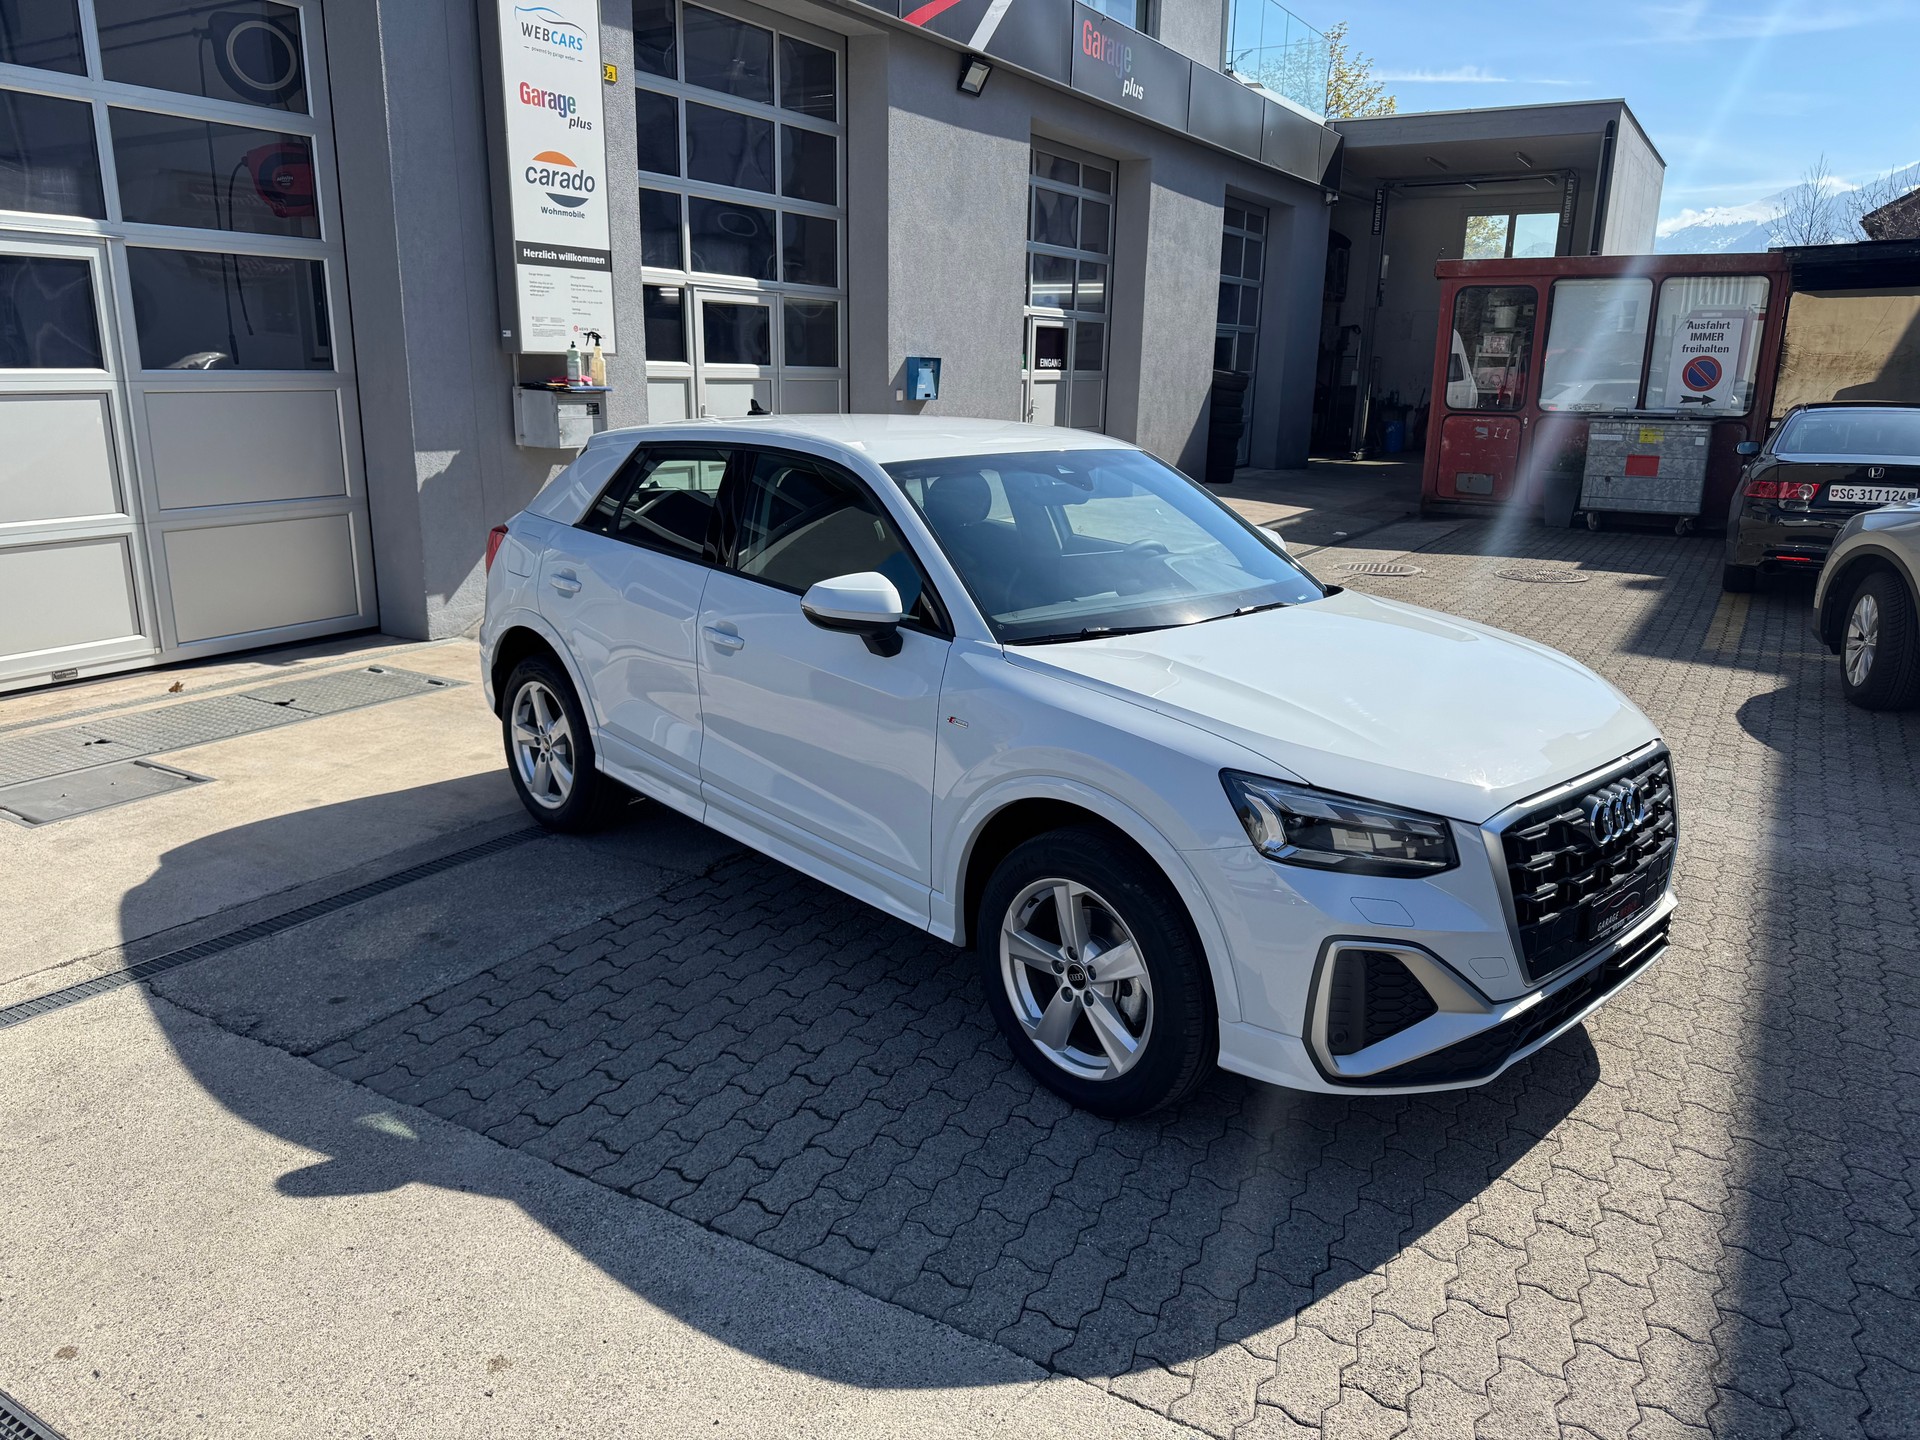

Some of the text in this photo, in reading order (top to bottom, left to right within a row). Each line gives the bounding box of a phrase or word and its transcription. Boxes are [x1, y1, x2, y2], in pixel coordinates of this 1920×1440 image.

[521, 21, 583, 51] WEBCARS
[1082, 19, 1132, 79] Garage
[1122, 77, 1144, 100] plus
[519, 81, 576, 118] Garage
[568, 116, 592, 131] plus
[525, 166, 595, 193] carado
[540, 206, 586, 219] Wohnmobile
[523, 248, 606, 265] Herzlich willkommen
[1686, 320, 1731, 330] Ausfahrt
[1690, 332, 1725, 342] IMMER
[1682, 344, 1730, 353] freihalten
[1040, 358, 1061, 368] EINGANG
